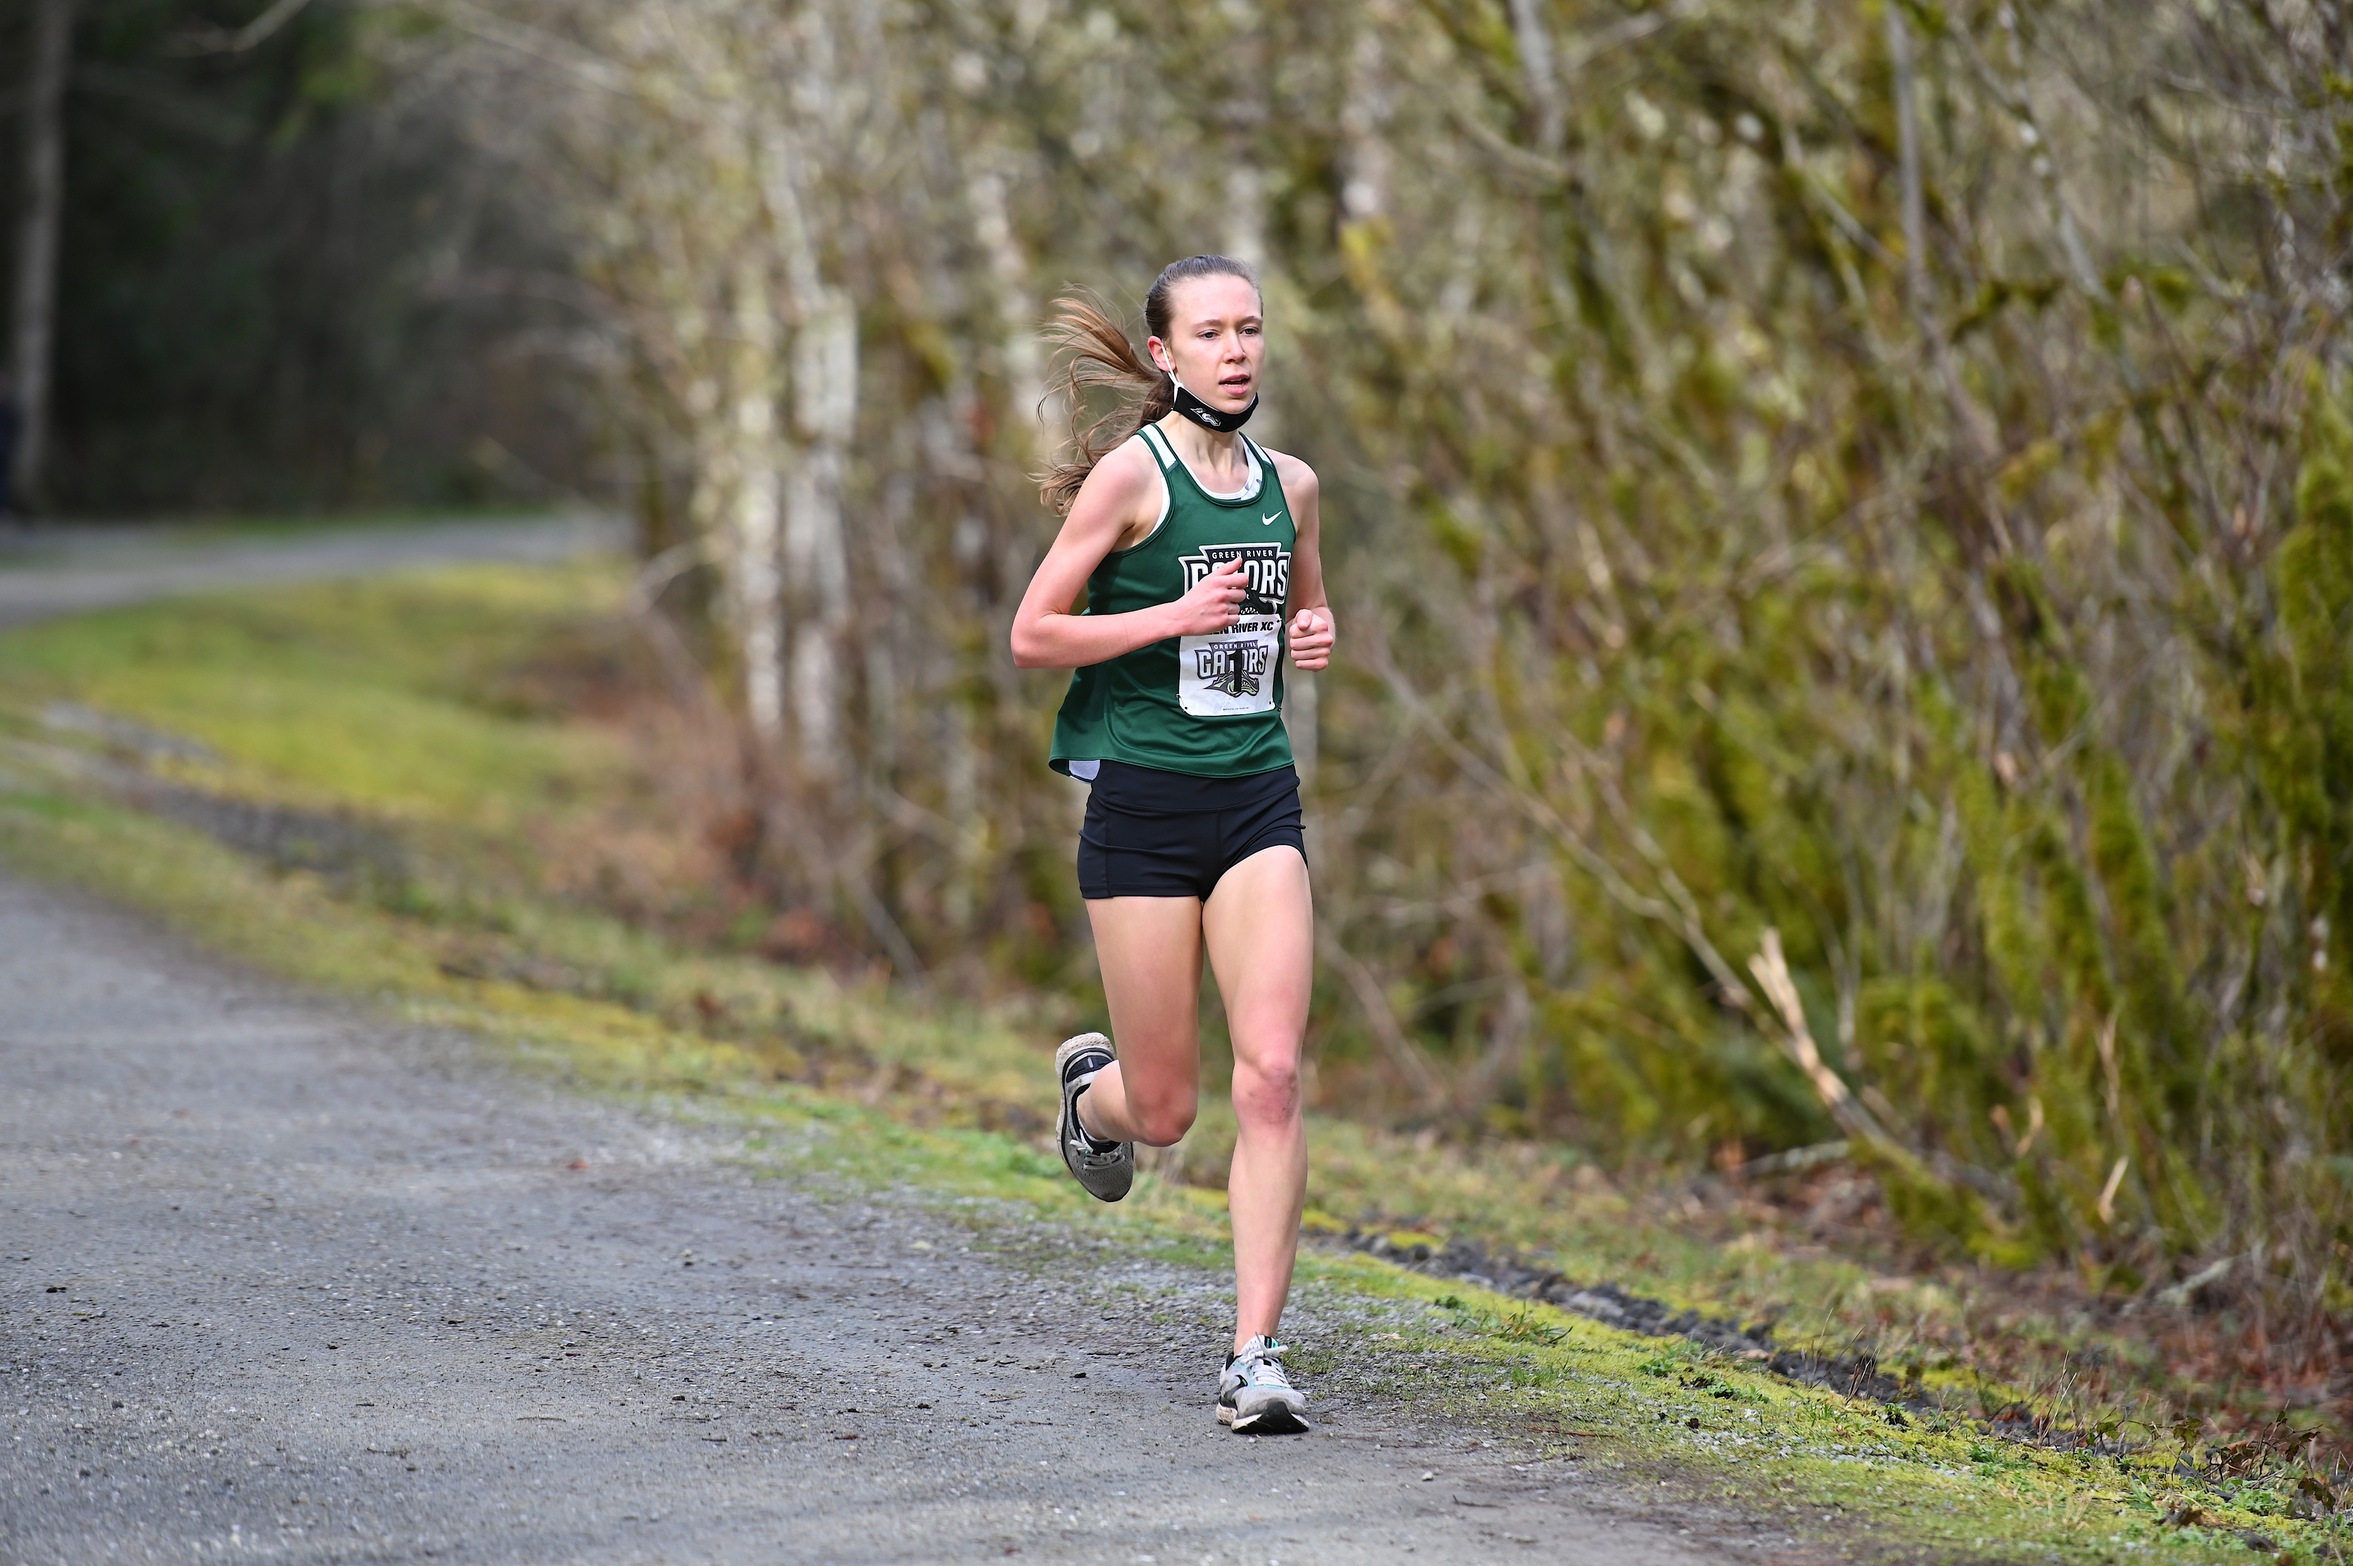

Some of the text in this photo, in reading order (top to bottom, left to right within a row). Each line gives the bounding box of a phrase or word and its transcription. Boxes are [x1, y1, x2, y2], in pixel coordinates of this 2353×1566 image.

[1211, 549, 1273, 559] GREEN RIVER
[1190, 559, 1288, 597] ORS
[1232, 622, 1258, 634] RIVER
[1260, 621, 1274, 631] XC
[1227, 649, 1242, 692] 1
